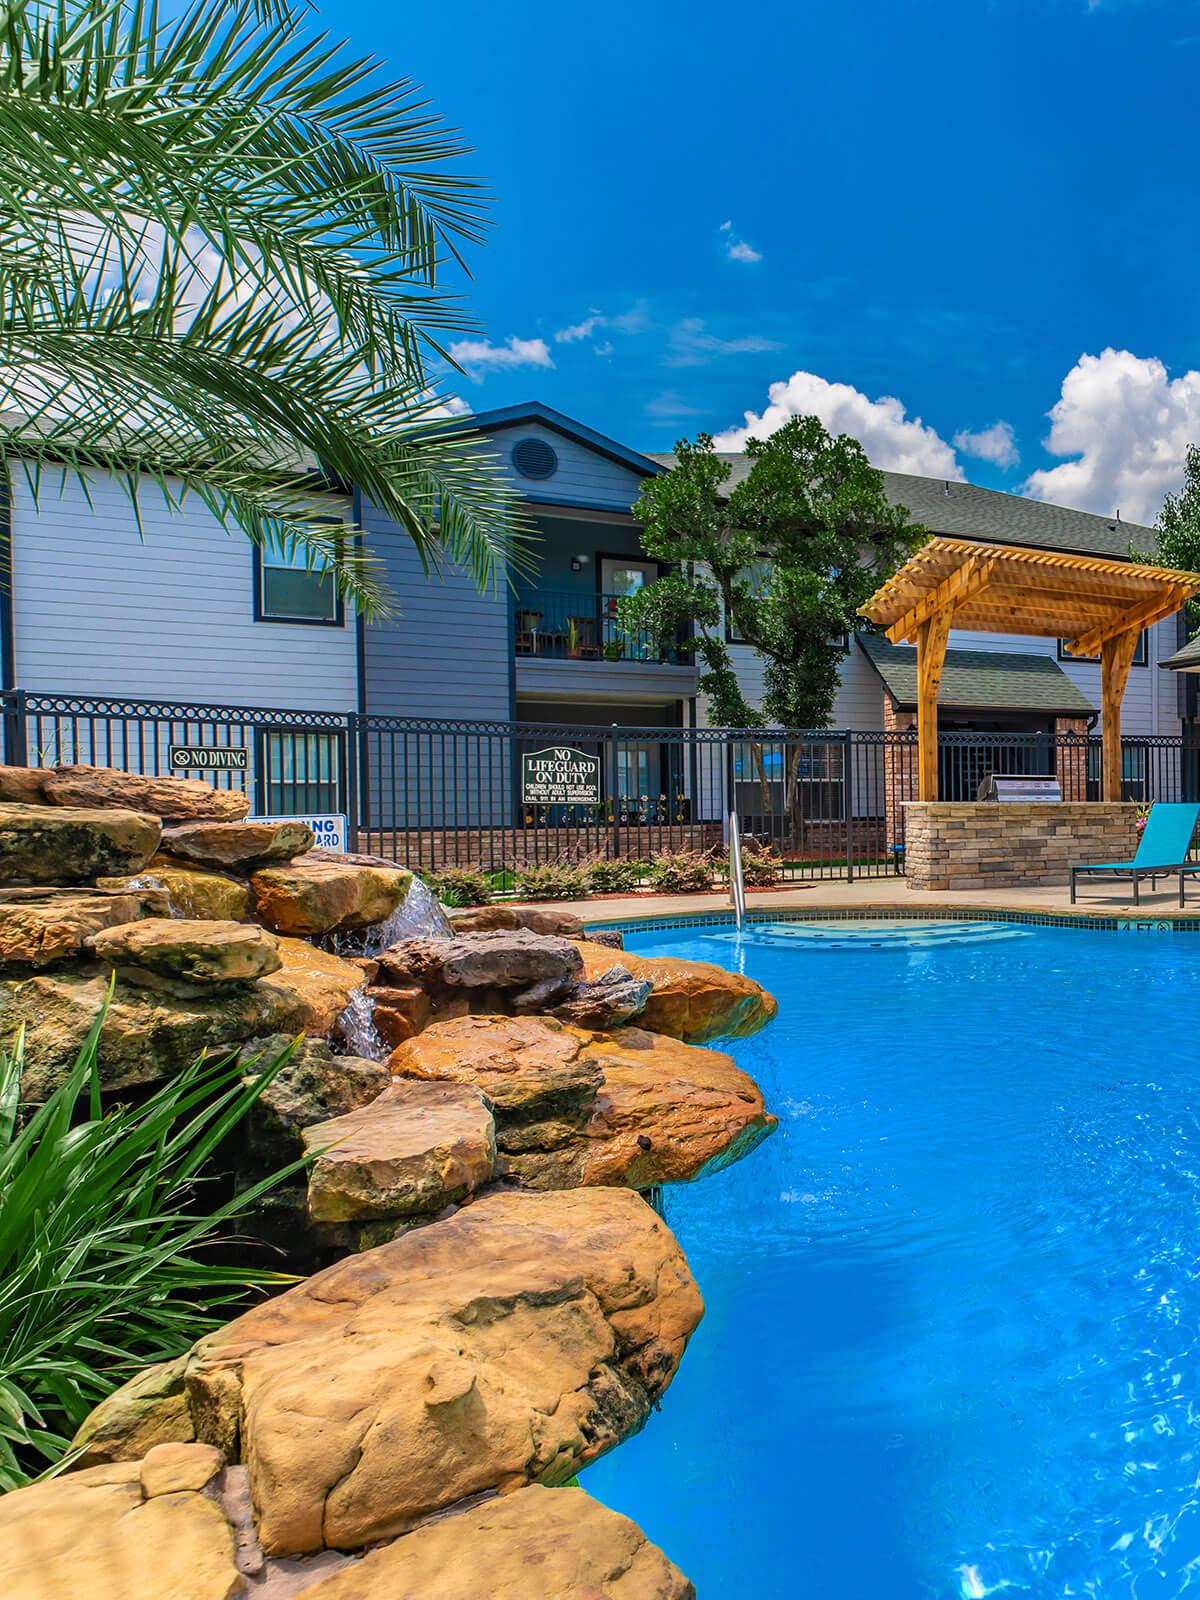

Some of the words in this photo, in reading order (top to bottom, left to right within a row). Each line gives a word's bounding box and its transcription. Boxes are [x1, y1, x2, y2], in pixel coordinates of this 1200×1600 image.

[191, 751, 208, 766] NO
[209, 751, 246, 767] DIVING
[554, 749, 572, 761] NO
[527, 760, 596, 773] LIFEGUARD
[536, 771, 554, 783] ON
[556, 772, 589, 784] DUTY
[1136, 922, 1153, 932] FT
